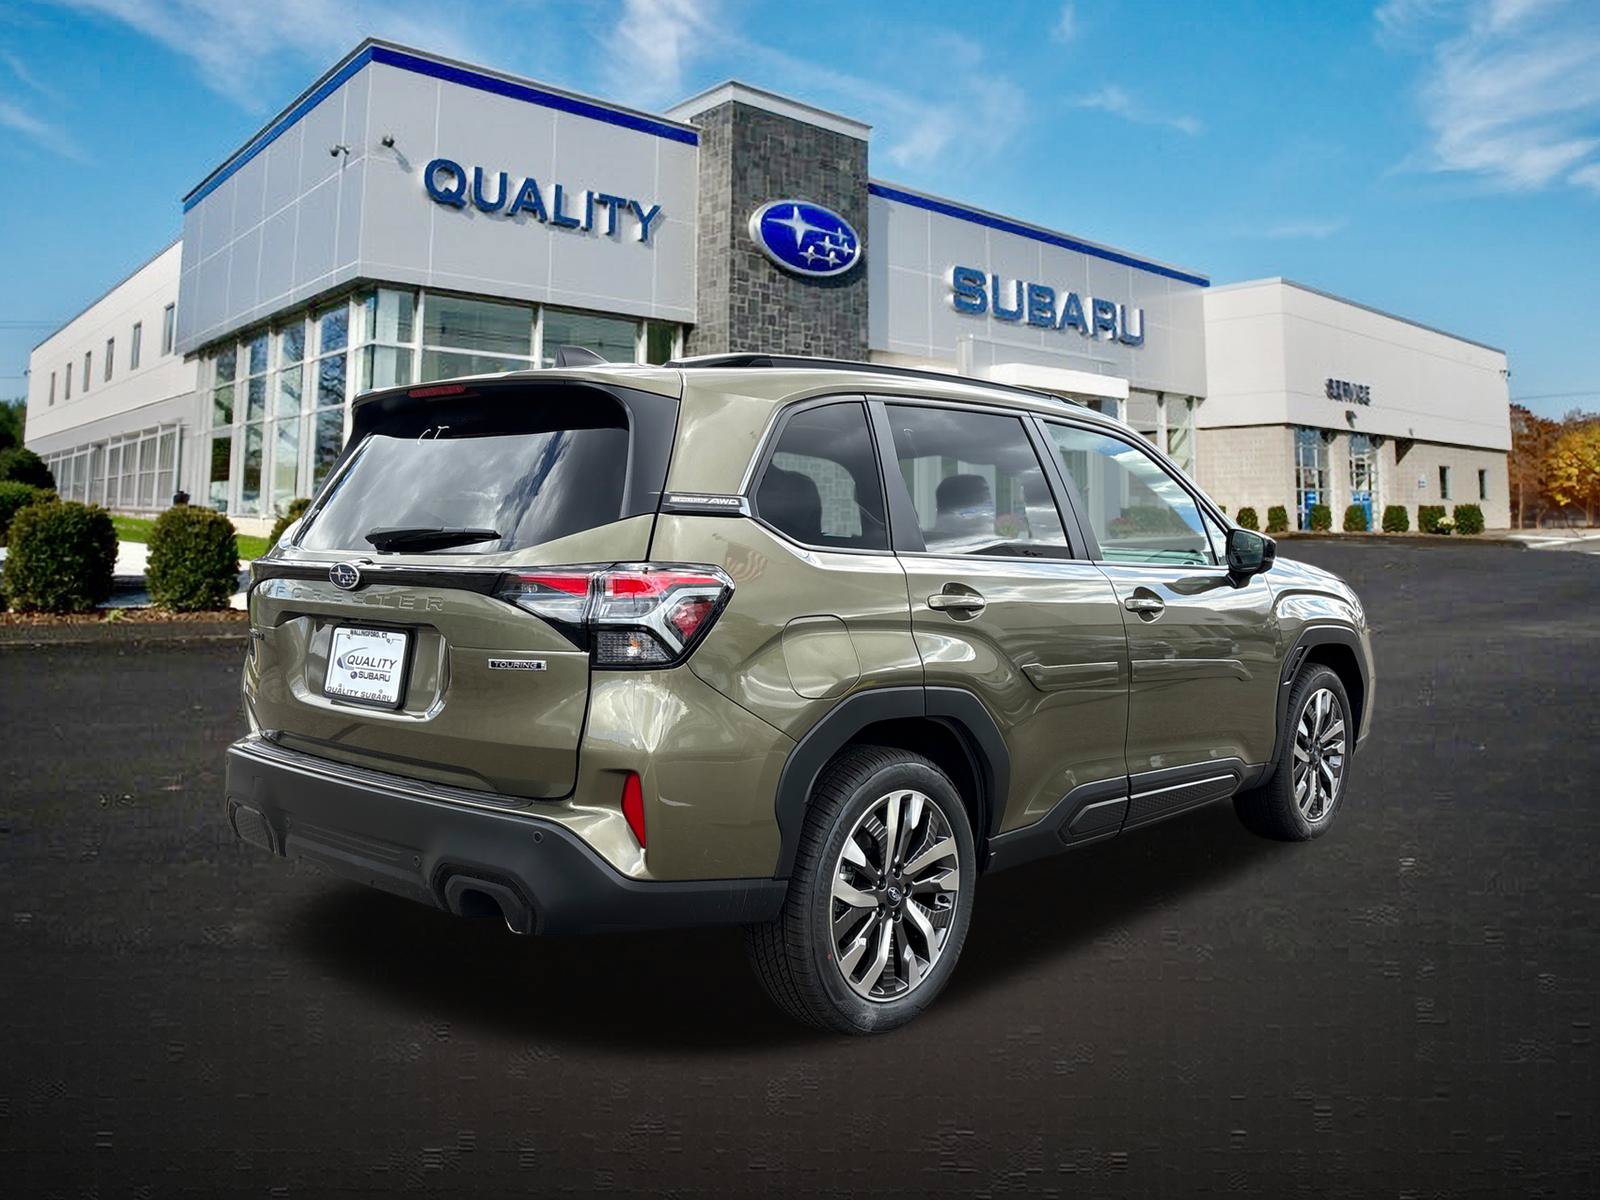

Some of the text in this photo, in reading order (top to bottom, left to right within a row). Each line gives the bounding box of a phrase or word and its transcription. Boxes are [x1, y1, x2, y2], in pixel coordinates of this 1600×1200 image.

[423, 158, 661, 243] QUALITY
[949, 265, 1145, 346] SUBARU
[276, 586, 445, 612] FORESTER
[347, 654, 398, 670] QUALITY
[494, 661, 538, 670] TOURING
[358, 671, 391, 682] SUBARU
[327, 686, 393, 701] QUALITY SUBARU
